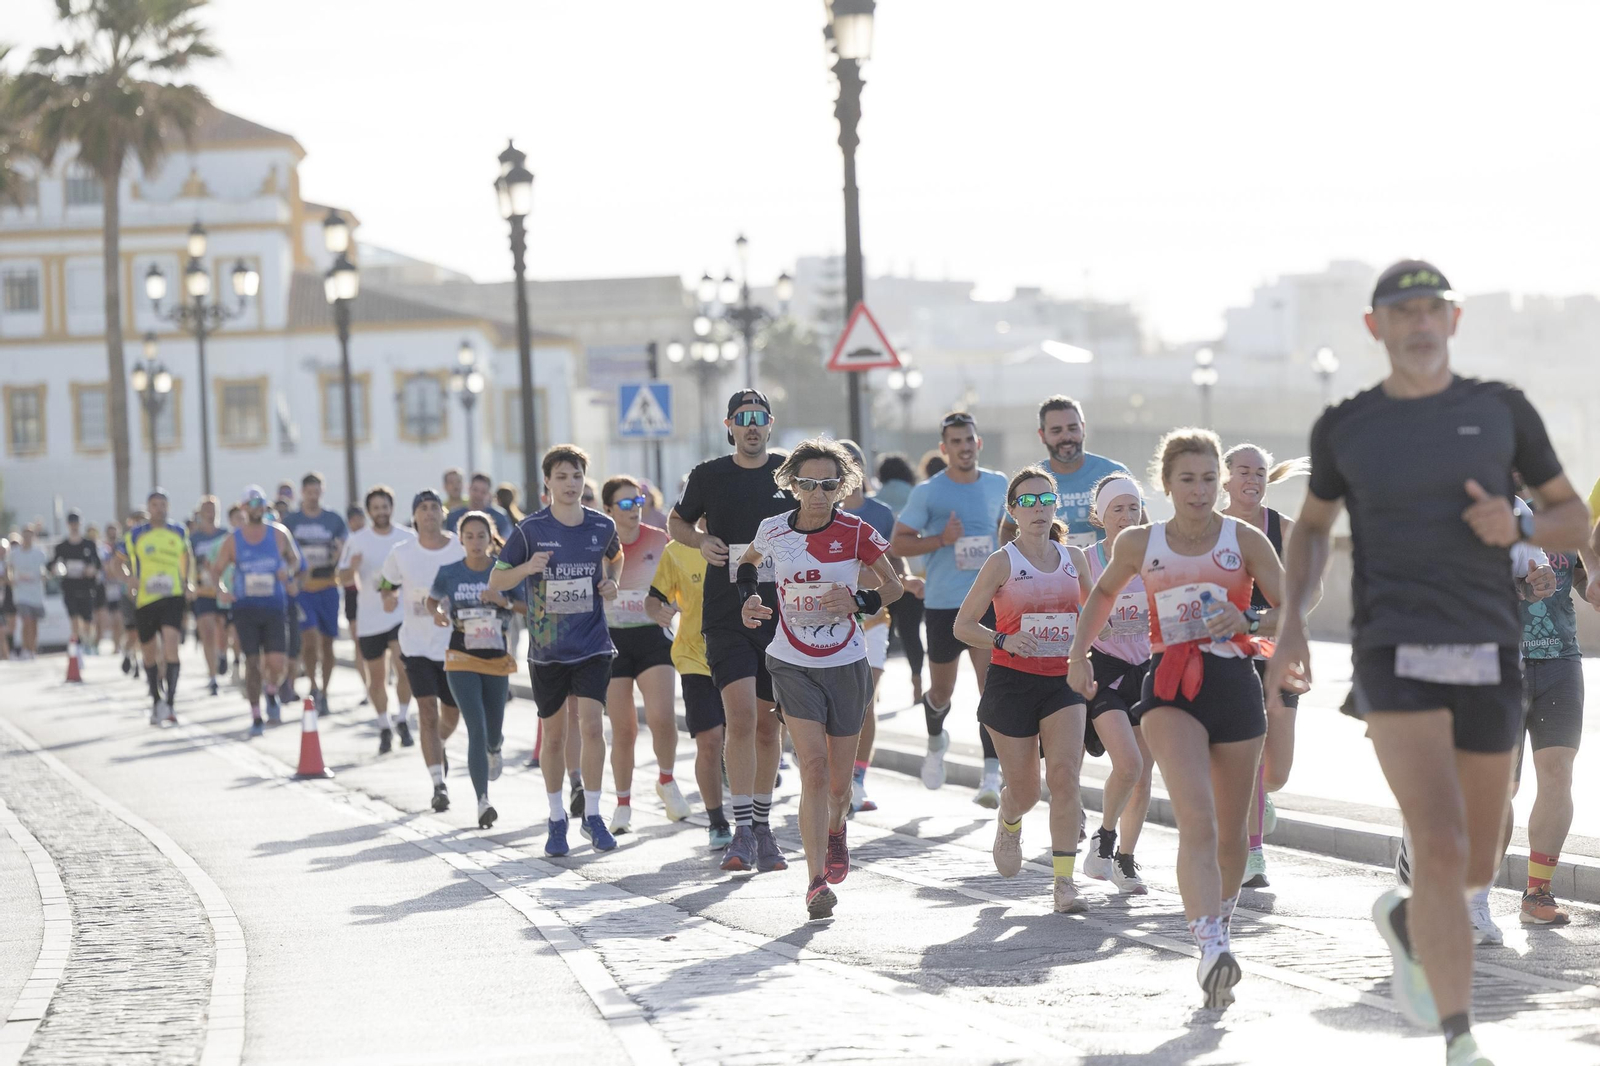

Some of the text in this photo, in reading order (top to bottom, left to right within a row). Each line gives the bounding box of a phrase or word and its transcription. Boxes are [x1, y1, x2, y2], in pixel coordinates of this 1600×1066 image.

[542, 565, 597, 577] EL PUERTO
[552, 588, 588, 603] 2354
[1118, 605, 1139, 621] 12
[1028, 626, 1070, 642] 1425
